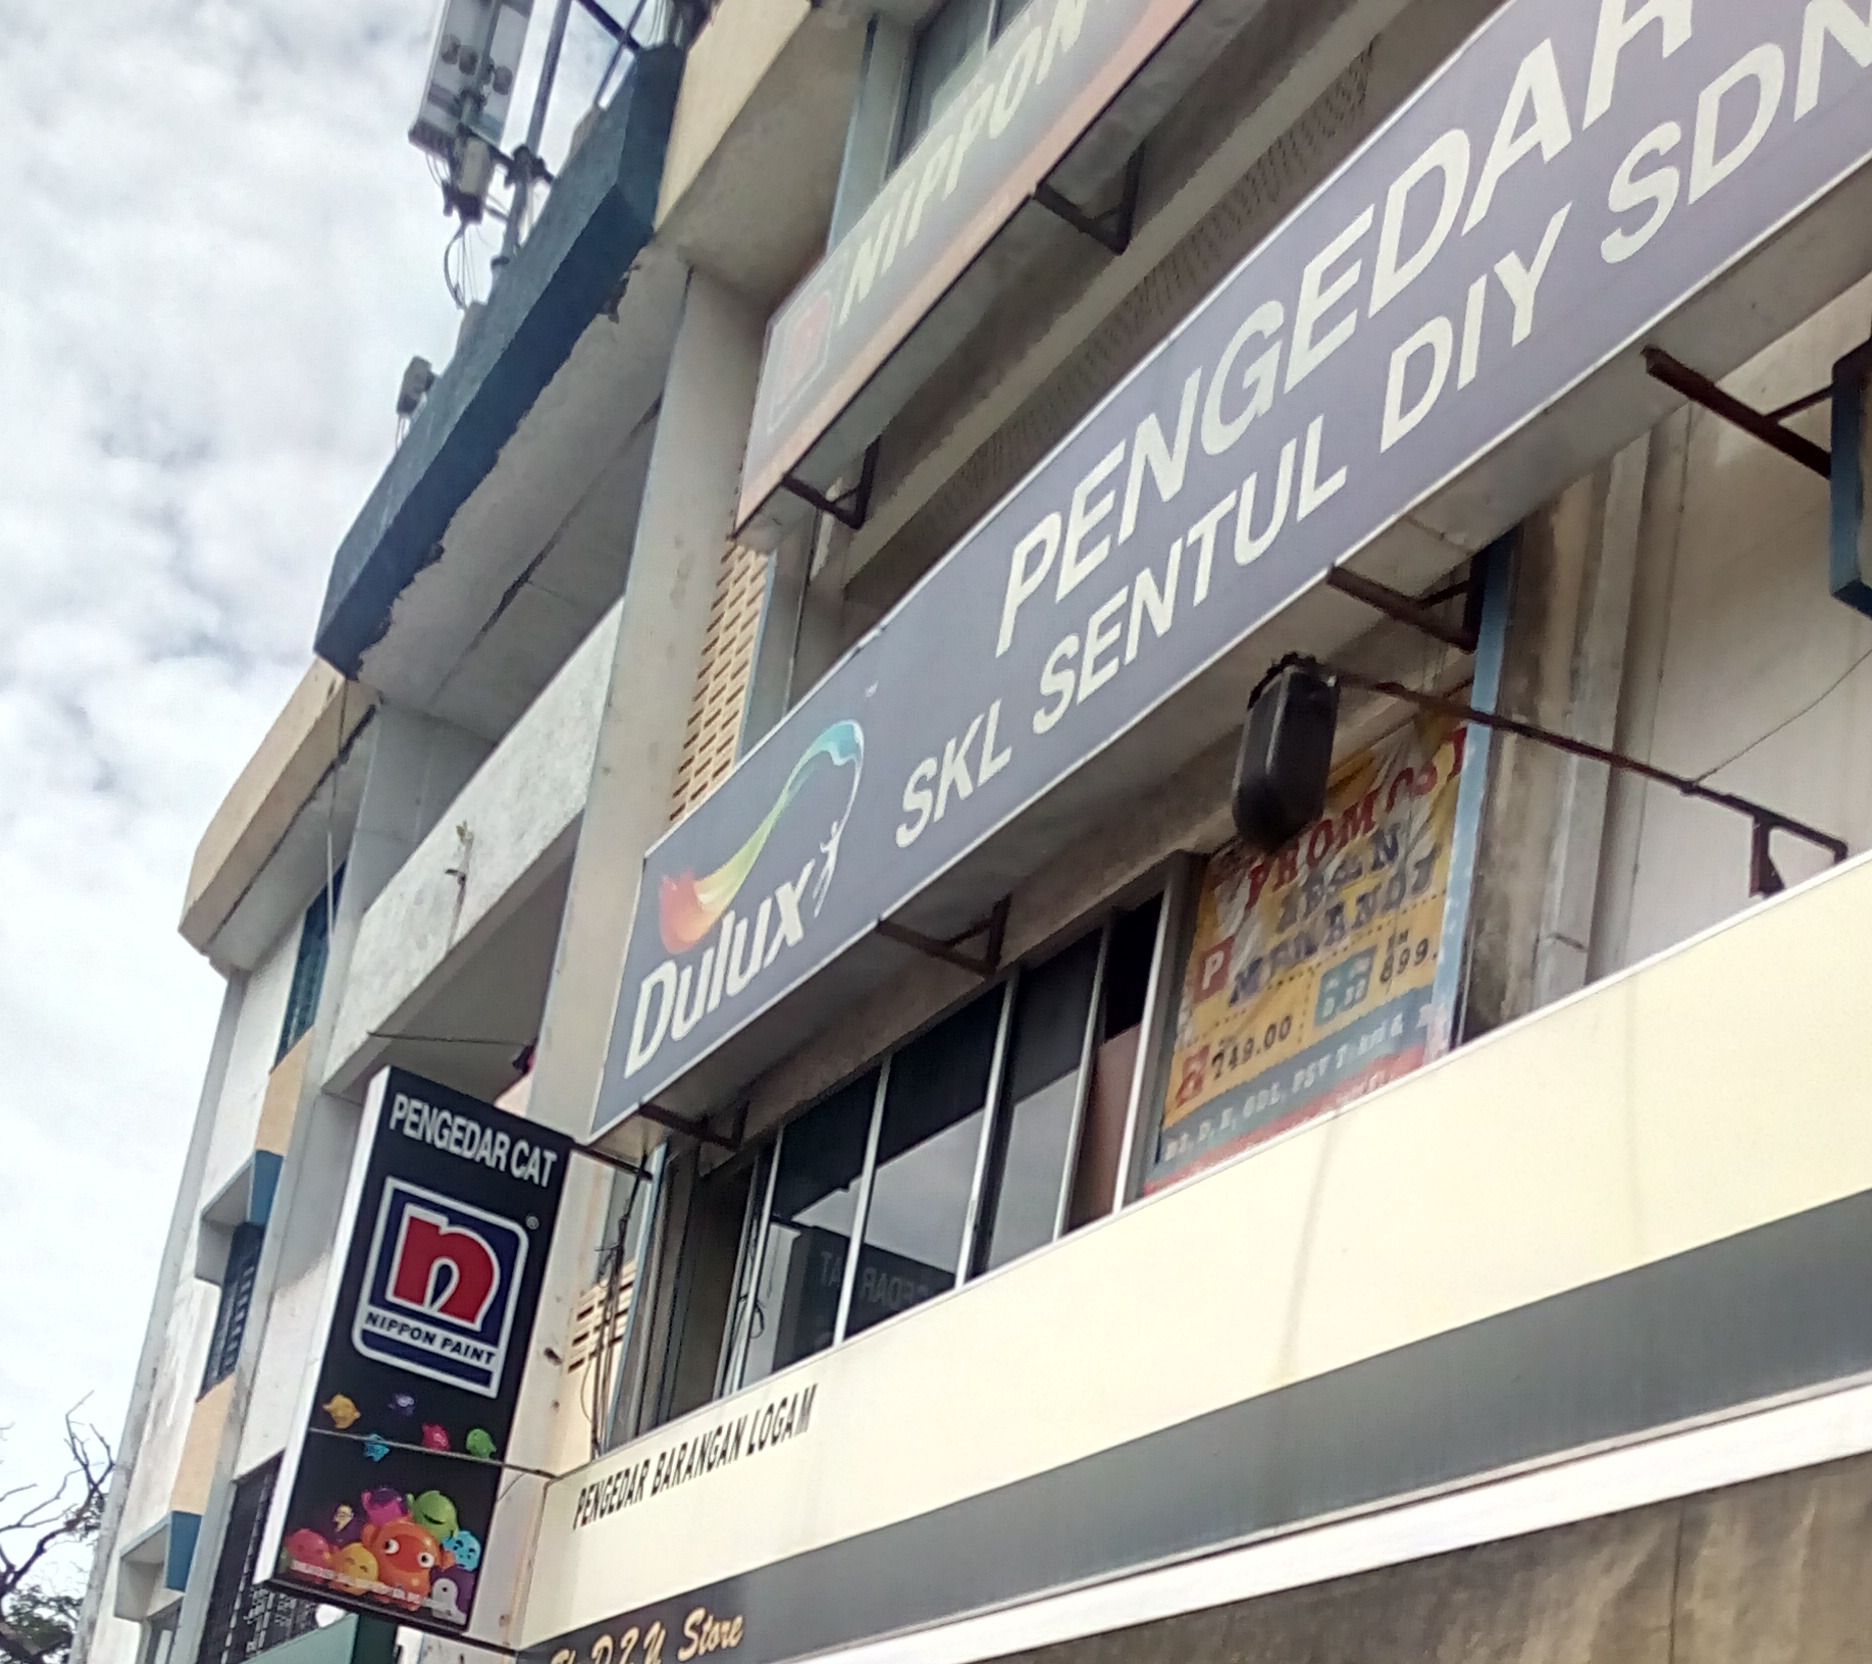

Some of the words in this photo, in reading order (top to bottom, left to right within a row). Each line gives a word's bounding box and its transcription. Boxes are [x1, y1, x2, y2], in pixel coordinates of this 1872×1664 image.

[837, 0, 1087, 326] NIPPON
[896, 697, 1013, 848] SKL
[1032, 413, 1348, 735] SENTUL
[1380, 200, 1573, 454] DIY
[1600, 0, 1872, 264] SDN
[624, 857, 818, 1080] Dulux
[389, 1093, 511, 1172] PENGEDAR
[510, 1139, 558, 1188] CAT
[365, 1311, 438, 1347] NIPPON
[440, 1336, 496, 1365] PAINT
[572, 1457, 652, 1531] PENGEDAR
[650, 1414, 748, 1498] BARANGAN
[745, 1383, 818, 1456] LOGAM
[677, 1606, 745, 1663] Store
